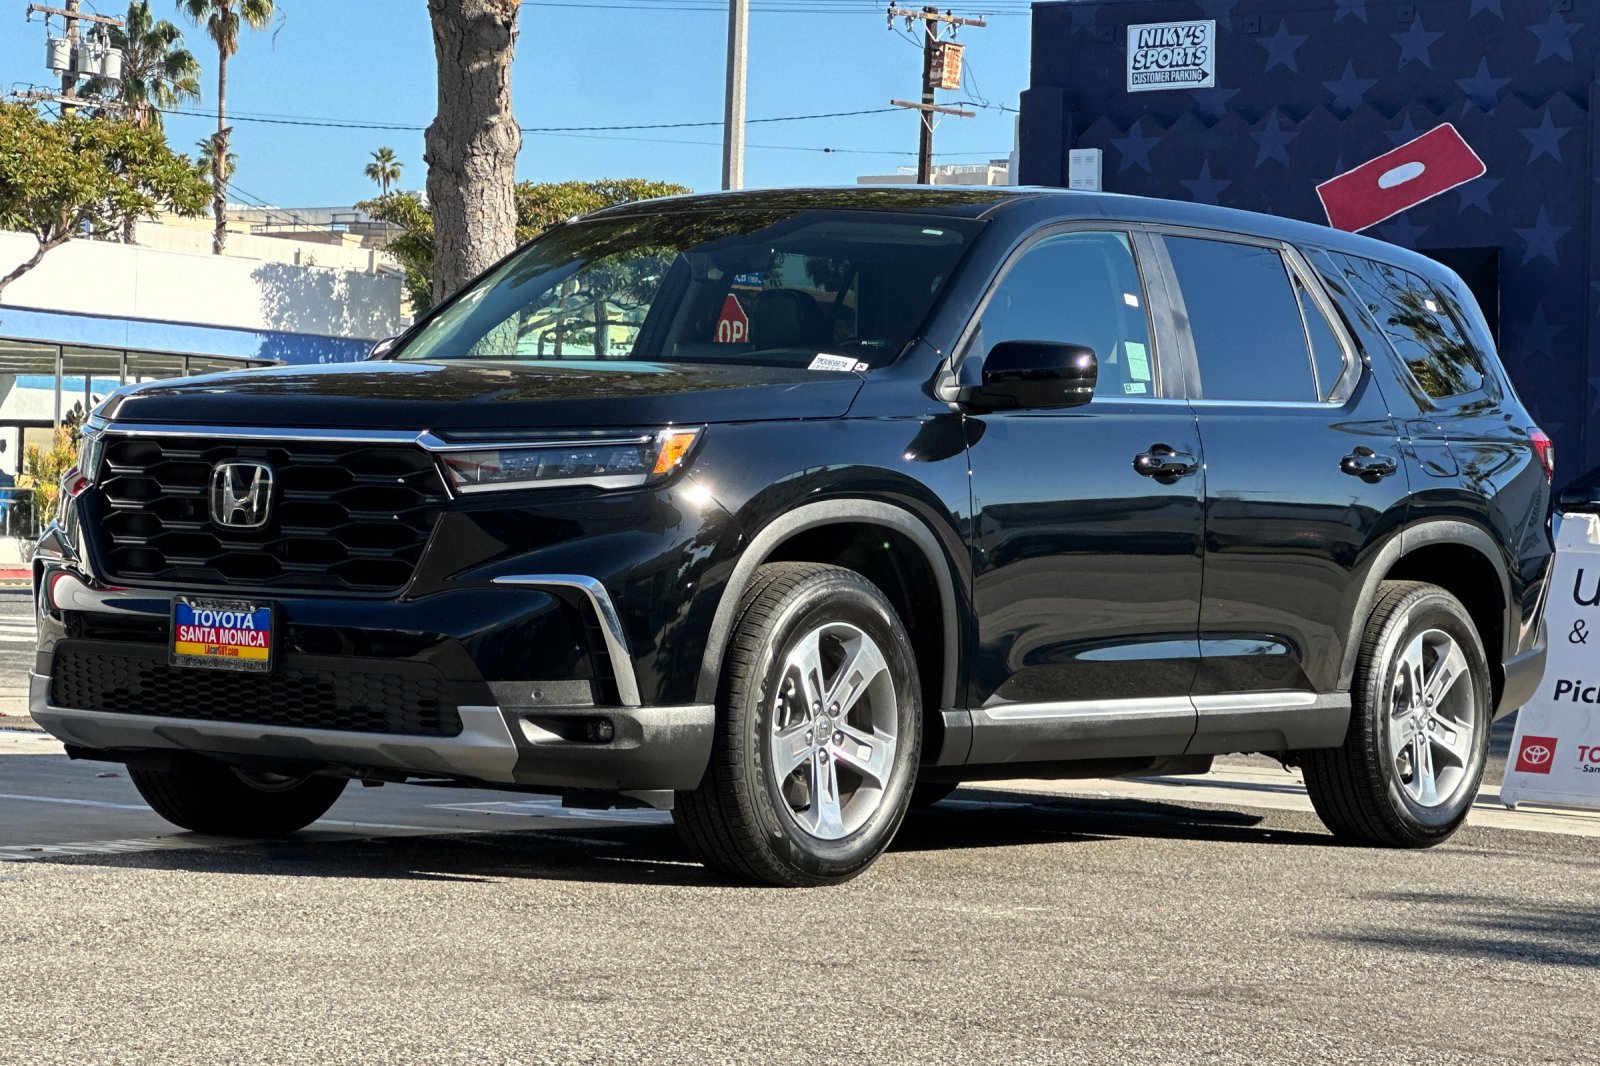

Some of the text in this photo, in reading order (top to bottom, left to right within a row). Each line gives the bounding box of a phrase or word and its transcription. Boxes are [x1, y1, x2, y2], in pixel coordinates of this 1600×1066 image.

[1138, 25, 1206, 49] NIKY'S
[1132, 46, 1207, 70] SPORTS
[1133, 69, 1203, 84] CUSTOMER PARKING
[192, 609, 254, 630] TOYOTA
[180, 626, 265, 647] SANTA MONICA
[1568, 619, 1589, 645] &
